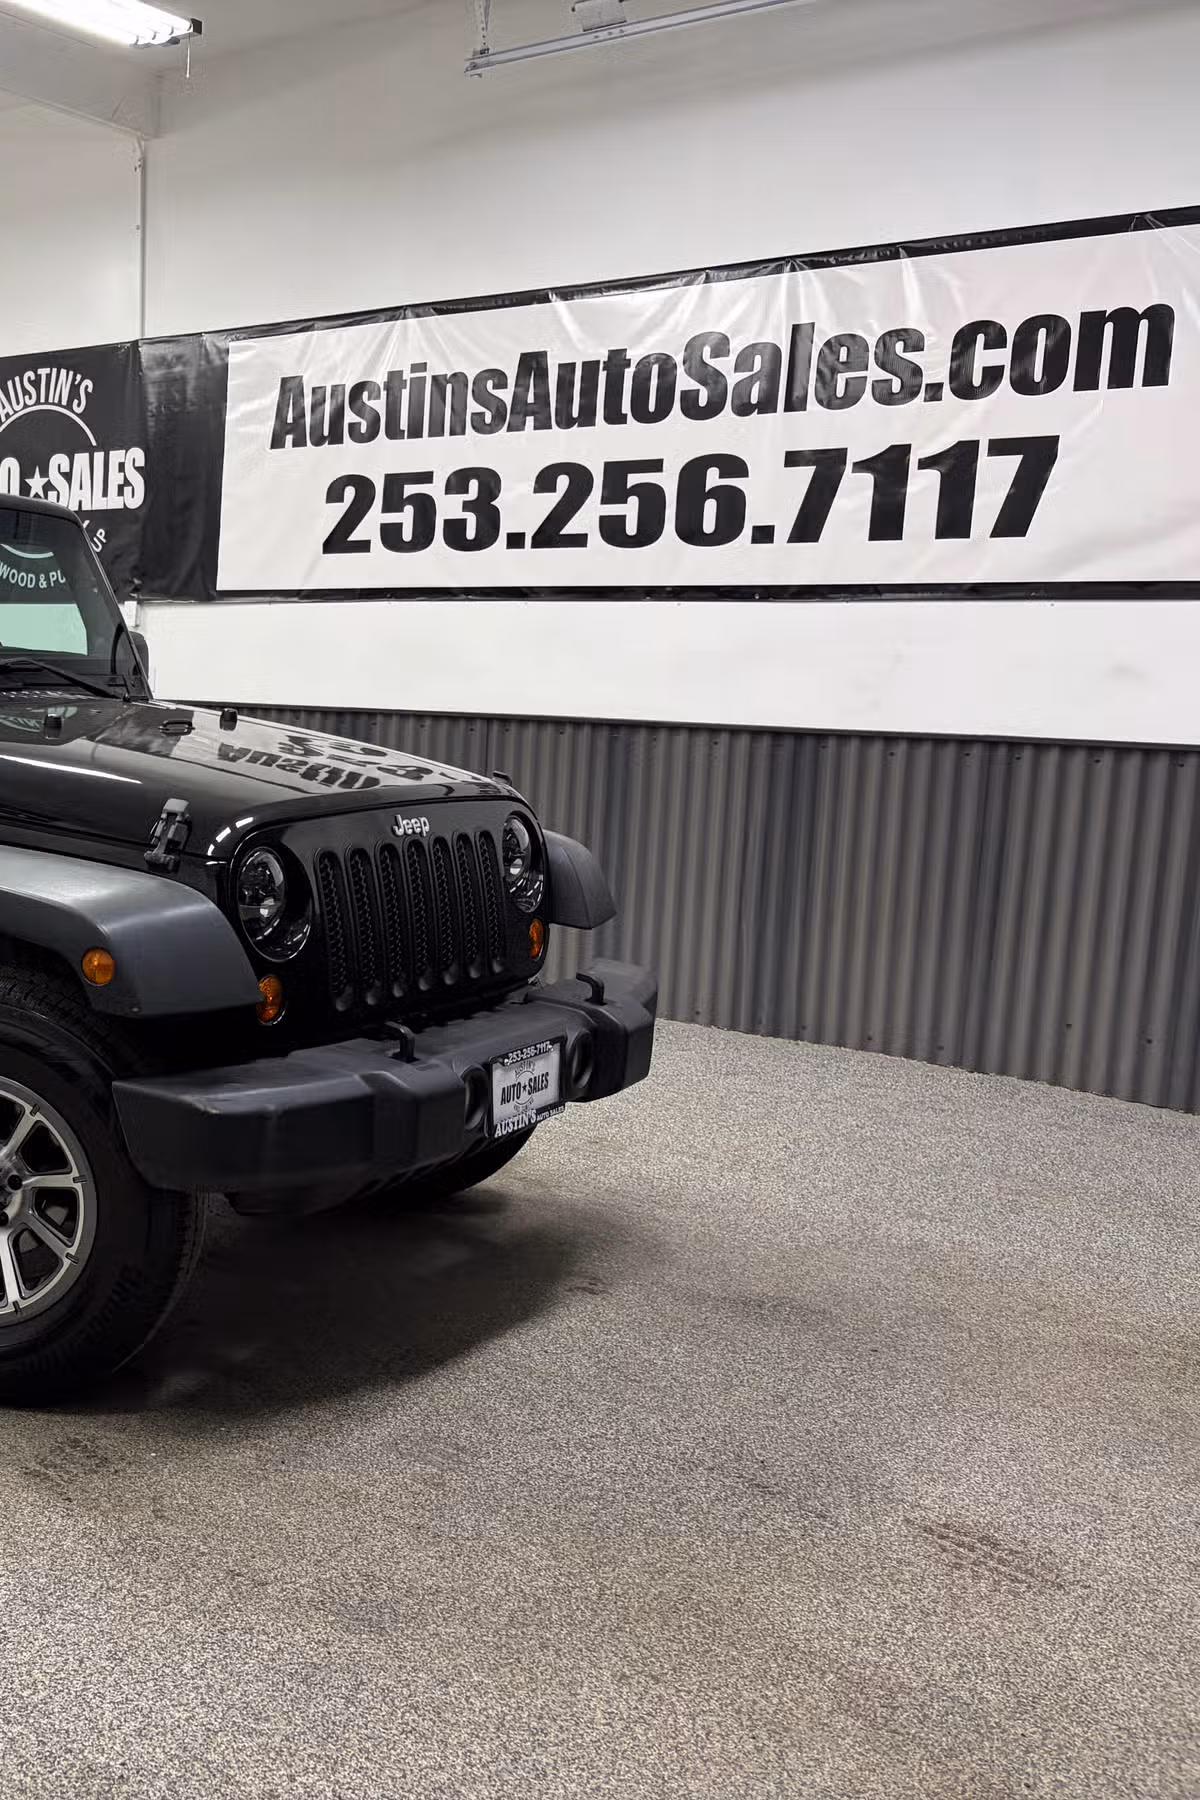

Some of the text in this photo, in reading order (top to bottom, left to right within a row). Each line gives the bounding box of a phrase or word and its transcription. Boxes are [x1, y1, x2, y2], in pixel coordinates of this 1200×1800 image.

[270, 302, 1175, 451] AustinsAutoSales.com
[47, 446, 146, 512] SALES
[322, 434, 1060, 556] 253.256.7117
[392, 813, 430, 837] Jeep
[499, 1081, 522, 1105] AUTO
[527, 1071, 549, 1095] SALES
[494, 1109, 537, 1138] AUSTIN'S
